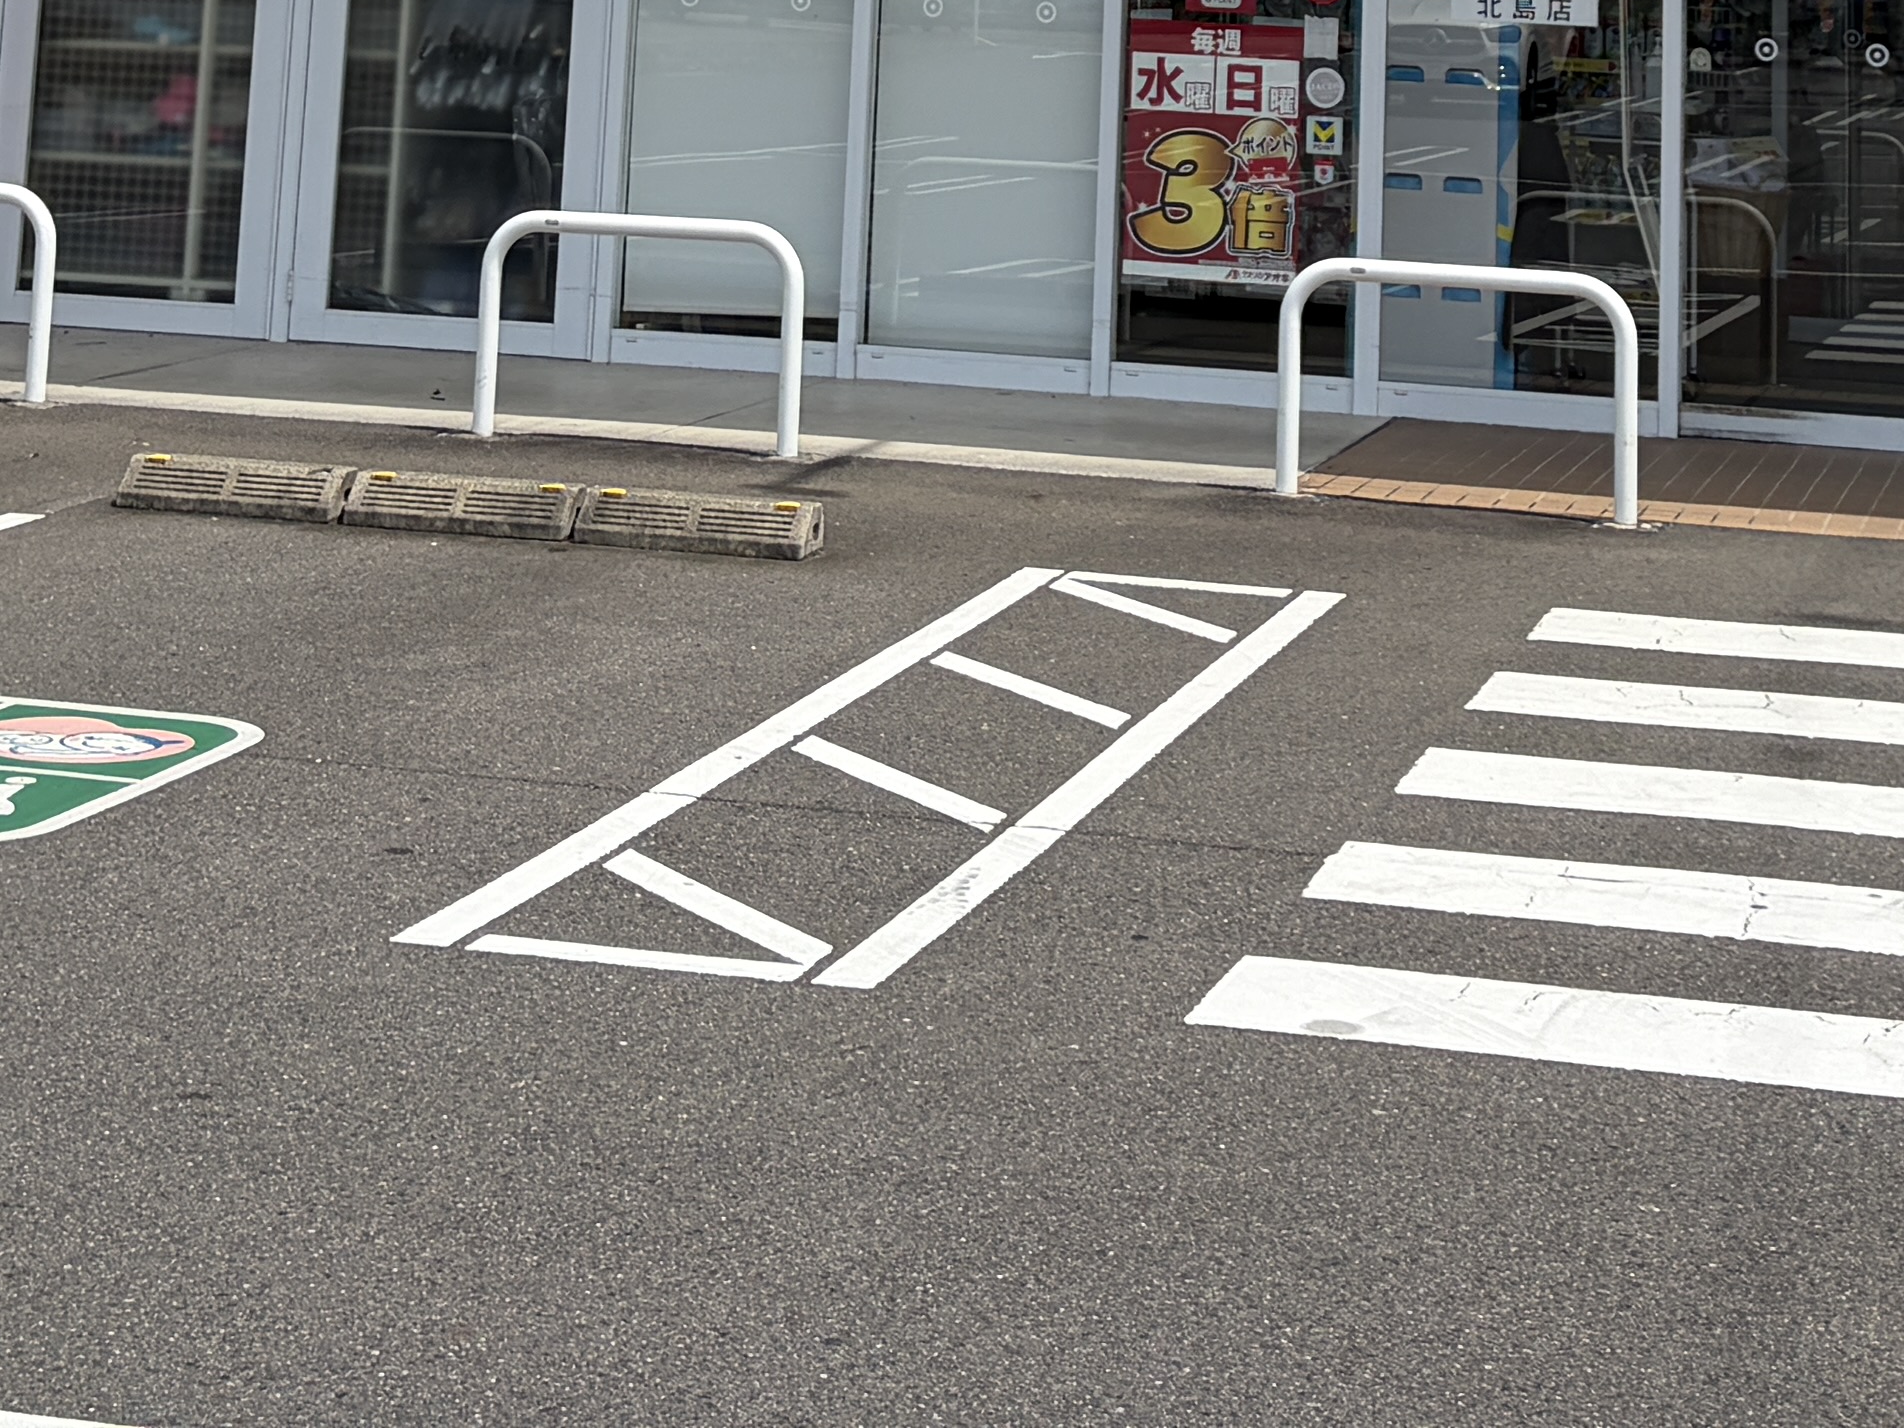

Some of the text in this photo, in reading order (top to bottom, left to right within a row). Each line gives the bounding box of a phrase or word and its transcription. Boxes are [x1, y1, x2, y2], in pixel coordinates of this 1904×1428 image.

[1191, 27, 1241, 55] 毎週
[1242, 136, 1293, 155] ポイント
